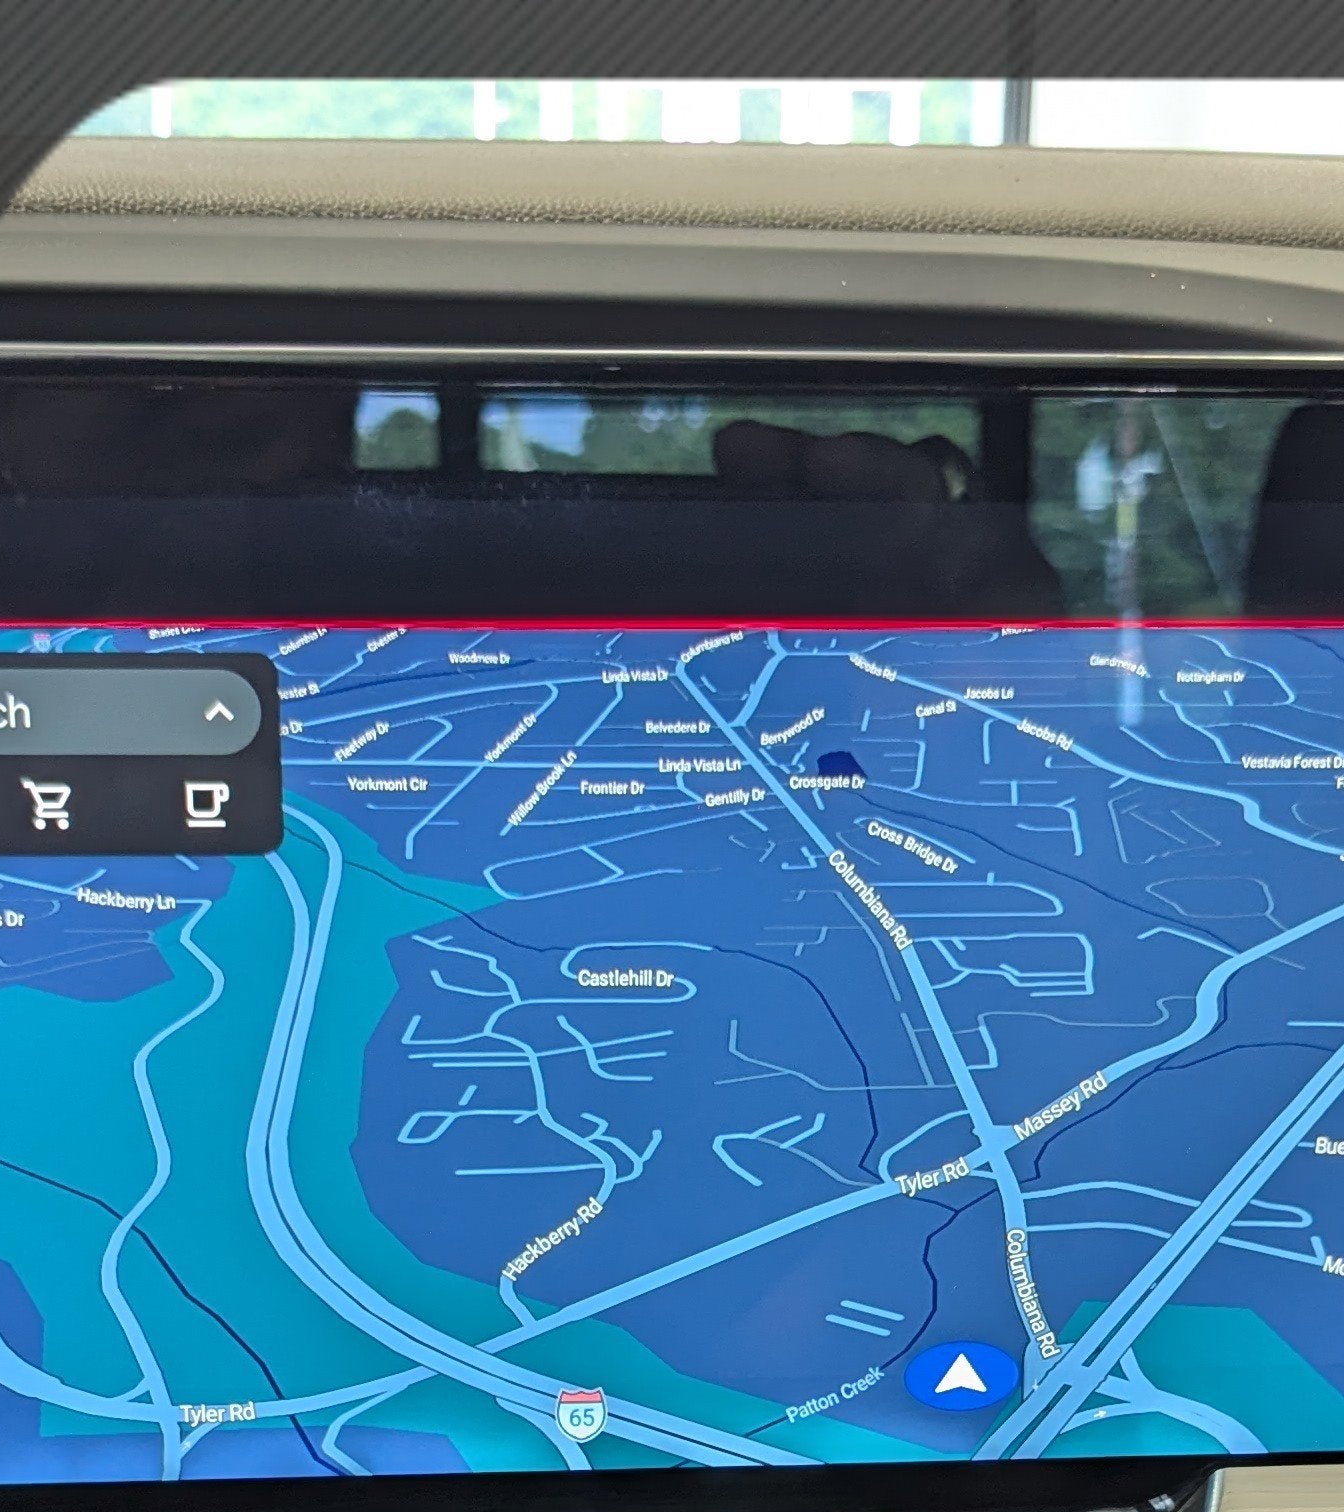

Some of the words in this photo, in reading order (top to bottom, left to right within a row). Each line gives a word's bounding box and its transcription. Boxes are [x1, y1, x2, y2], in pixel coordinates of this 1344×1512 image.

[681, 636, 731, 663] Columbiana
[730, 631, 744, 642] Rd
[499, 653, 510, 664] Dr
[602, 671, 628, 683] Linda
[630, 670, 657, 682] Vista
[656, 669, 668, 681] Dr
[882, 668, 897, 681] Rd
[1177, 671, 1229, 684] Nottingham
[1232, 672, 1245, 682] Dr
[964, 688, 999, 700] Jacobs
[1000, 688, 1014, 700] Ln
[916, 702, 944, 718] Canal
[944, 700, 957, 712] St
[645, 721, 696, 734] Belvedere
[698, 722, 710, 734] Dr
[761, 716, 813, 746] Berrywood
[810, 708, 825, 724] Dr
[1017, 719, 1056, 744] Jacobs
[1055, 734, 1073, 751] Rd
[334, 725, 377, 762] Fleetway
[375, 721, 390, 735] Dr
[484, 721, 528, 763] Yorkmont
[524, 712, 537, 728] Dr
[658, 759, 691, 772] Linda
[692, 759, 725, 772] Vista
[725, 759, 741, 771] Ln
[1242, 756, 1291, 769] Vestavia
[1293, 756, 1331, 769] Forest
[347, 777, 407, 791] Yorkmont
[408, 778, 428, 791] Cir
[508, 784, 544, 827] Willow
[537, 764, 566, 797] Brook
[562, 751, 577, 767] Ln
[580, 781, 628, 795] Frontier
[630, 781, 645, 795] Dr
[790, 776, 850, 790] Crossgate
[851, 776, 865, 790] Dr
[705, 791, 749, 807] Gentilly
[750, 788, 765, 802] Dr
[868, 821, 904, 848] Cross
[903, 835, 944, 867] Bridge
[938, 854, 958, 874] Dr
[77, 887, 155, 913] Hackberry
[155, 893, 176, 910] Ln
[828, 850, 896, 931] Columbiana
[888, 924, 913, 951] Rd
[5, 911, 25, 927] Dr
[577, 969, 653, 988] Castlehill
[656, 971, 675, 988] Dr
[1013, 1089, 1082, 1141] Massey
[1079, 1071, 1108, 1098] Rd
[895, 1171, 942, 1198] Tyler
[942, 1156, 970, 1184] Rd
[501, 1217, 584, 1282] Hackberry
[576, 1196, 604, 1226] Rd
[1007, 1229, 1046, 1334] Columbiana
[1036, 1329, 1061, 1359] Rd
[784, 1388, 840, 1424] Patton
[840, 1366, 885, 1401] Creek
[180, 1404, 227, 1427] Tyler
[230, 1401, 255, 1421] Rd
[569, 1407, 595, 1427] 65
